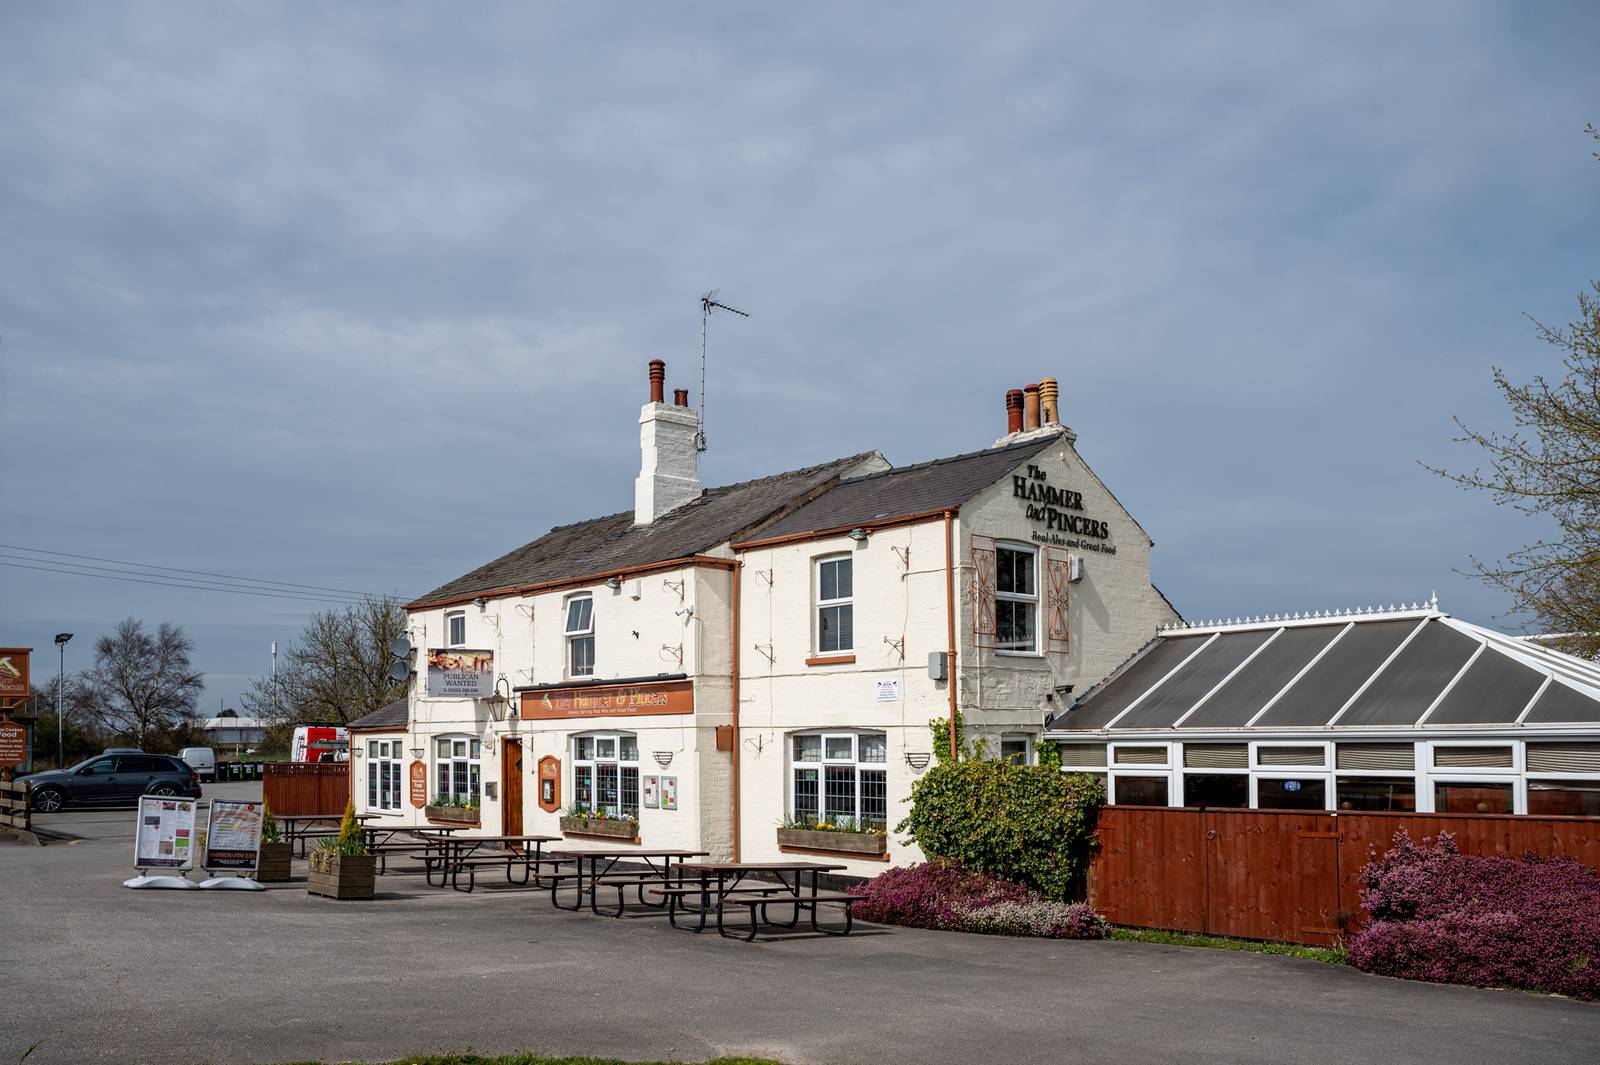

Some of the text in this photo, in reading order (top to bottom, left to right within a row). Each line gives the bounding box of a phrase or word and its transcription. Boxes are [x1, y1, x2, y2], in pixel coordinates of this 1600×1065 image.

[1027, 464, 1046, 481] The
[1013, 475, 1083, 510] HAMMER
[1026, 500, 1109, 539] and PINCERS
[1032, 531, 1117, 555] Real Ales and Great Food
[574, 690, 611, 708] Hammer
[616, 688, 627, 707] &
[629, 687, 668, 706] Pincers
